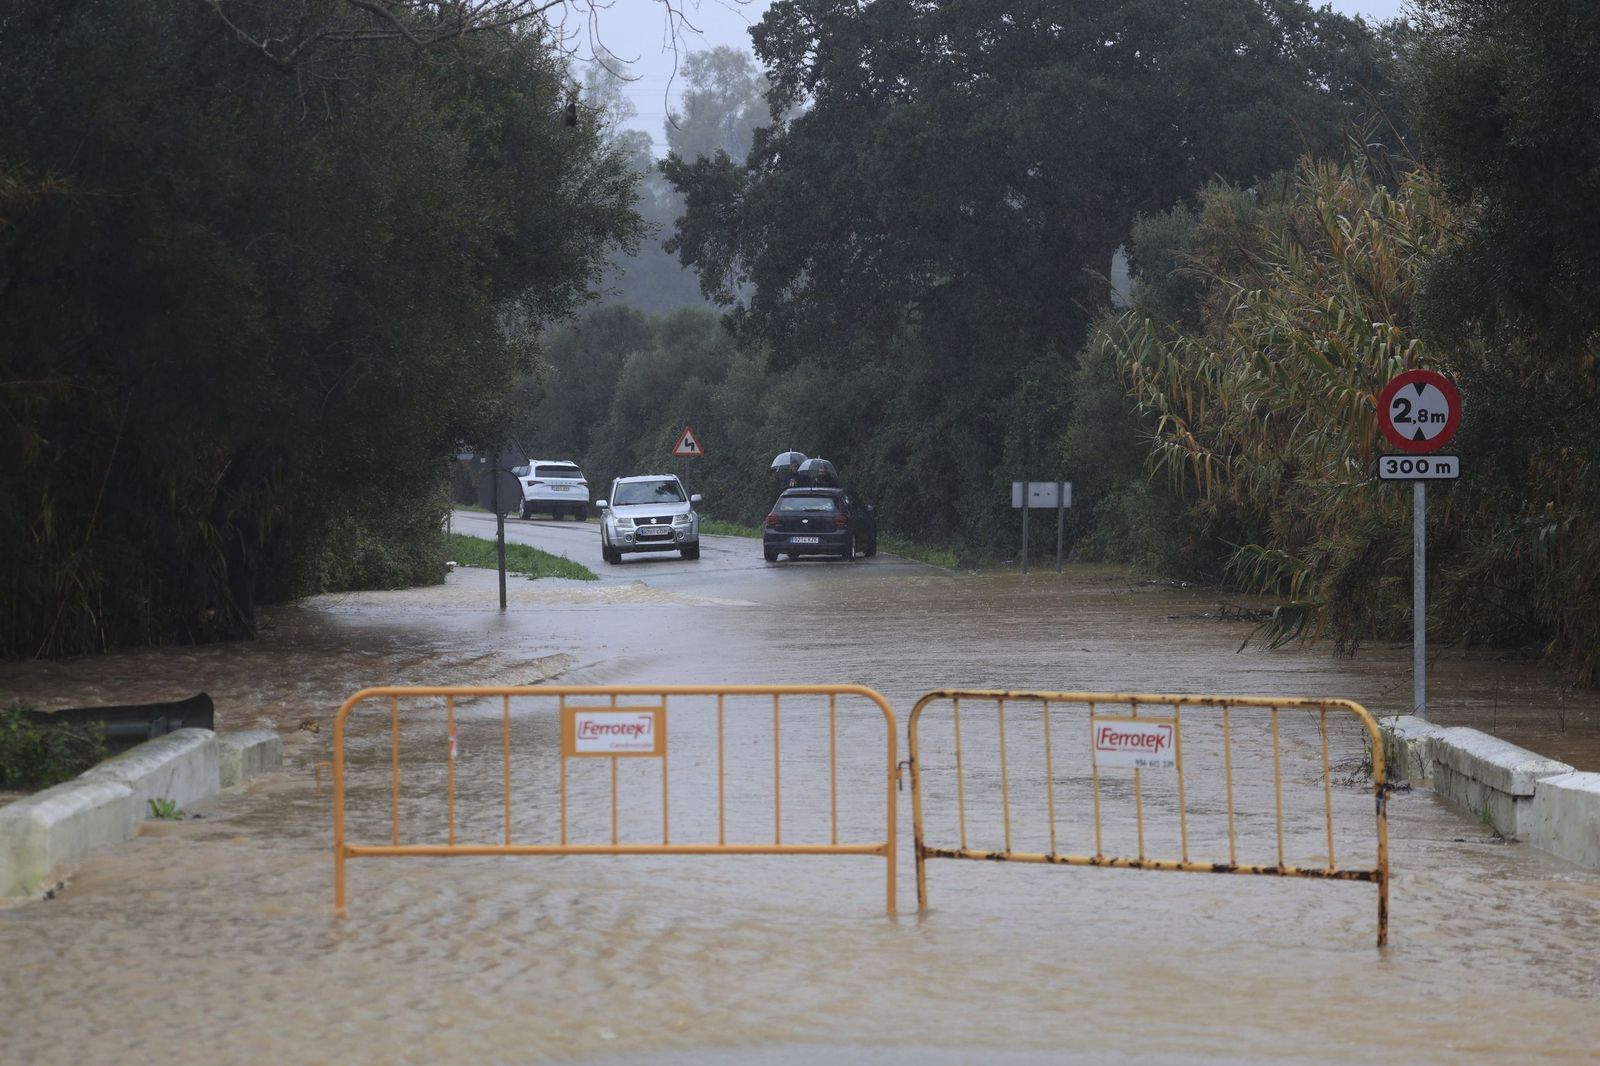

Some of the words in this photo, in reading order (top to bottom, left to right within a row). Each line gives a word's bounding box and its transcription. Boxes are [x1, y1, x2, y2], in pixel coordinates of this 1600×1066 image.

[1386, 459, 1430, 474] 300
[1435, 462, 1451, 474] m
[581, 720, 646, 739] Ferrotek
[1100, 727, 1167, 754] Ferrotek
